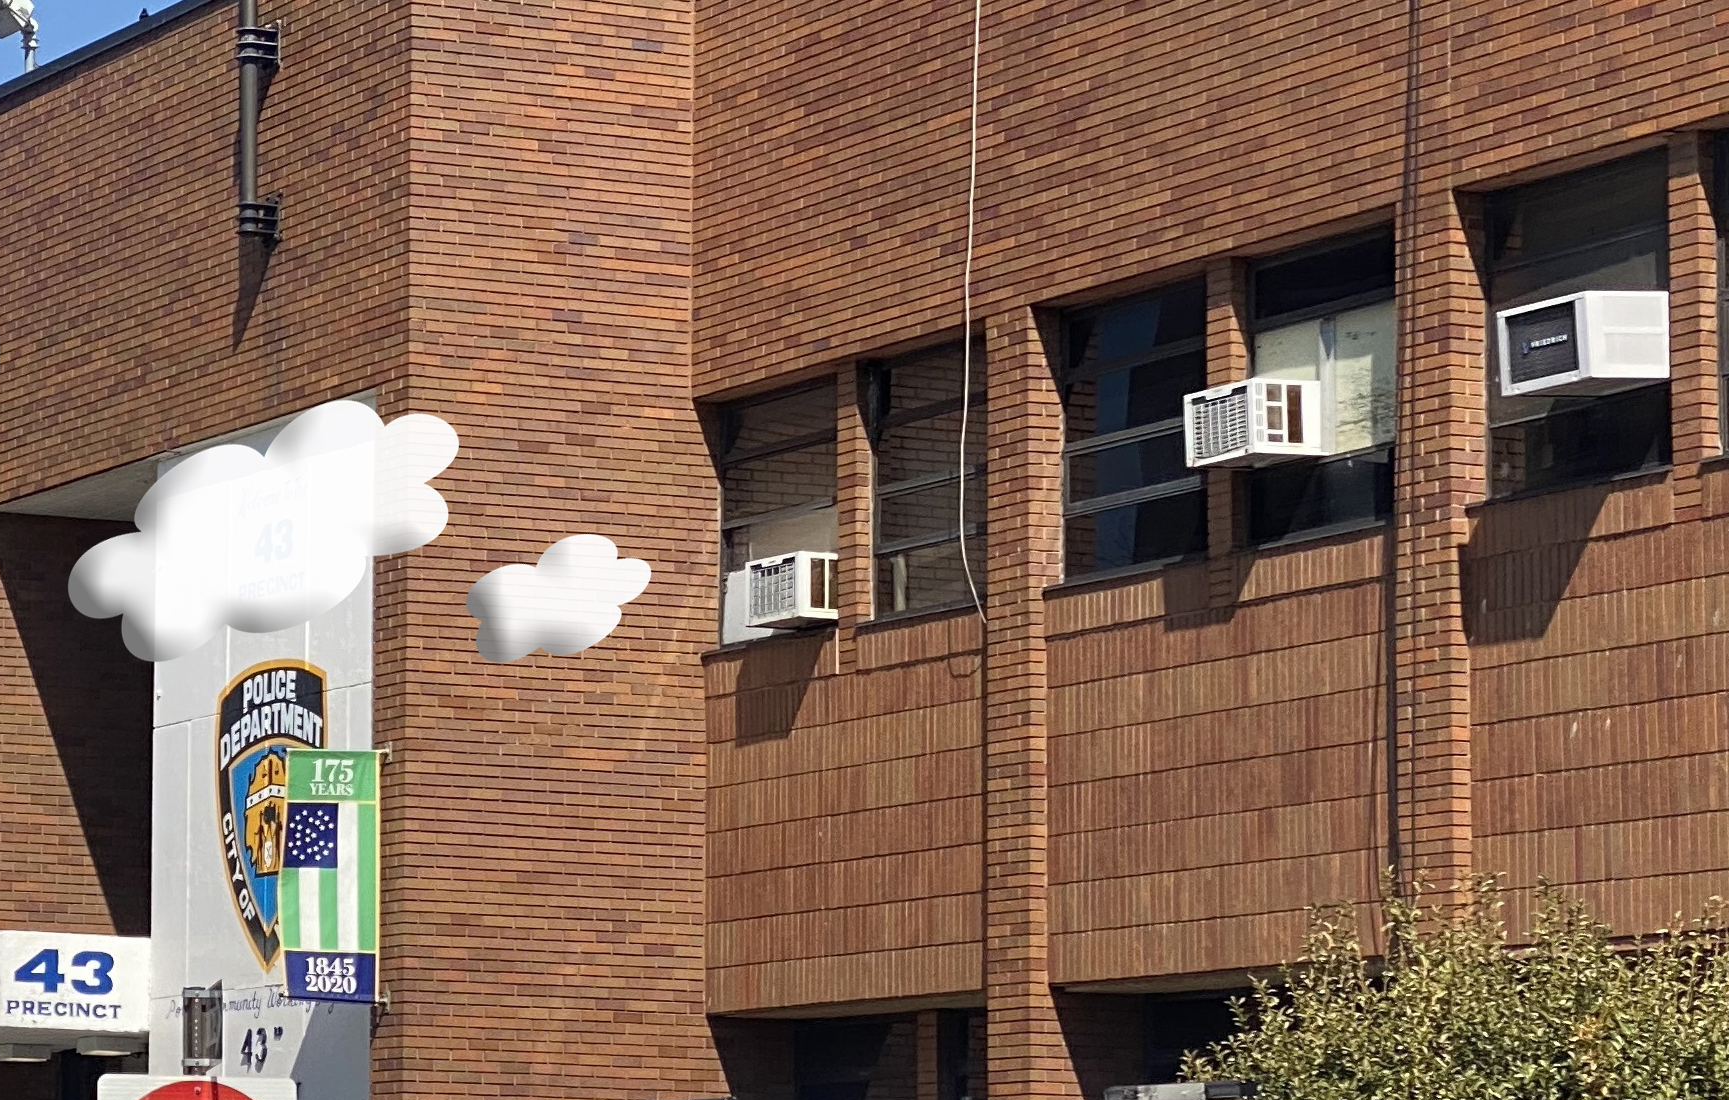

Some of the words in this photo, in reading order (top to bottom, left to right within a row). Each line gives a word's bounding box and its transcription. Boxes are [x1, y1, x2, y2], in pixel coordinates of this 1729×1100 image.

[242, 669, 297, 714] POLICE
[220, 702, 323, 771] DEPARTMENT
[311, 759, 354, 783] 175
[309, 783, 354, 797] YEARS
[222, 812, 244, 883] CITY
[238, 888, 256, 921] OF
[14, 949, 114, 996] 43
[305, 956, 355, 976] 1845
[305, 975, 357, 994] 2020
[6, 1000, 122, 1020] PRECINCT
